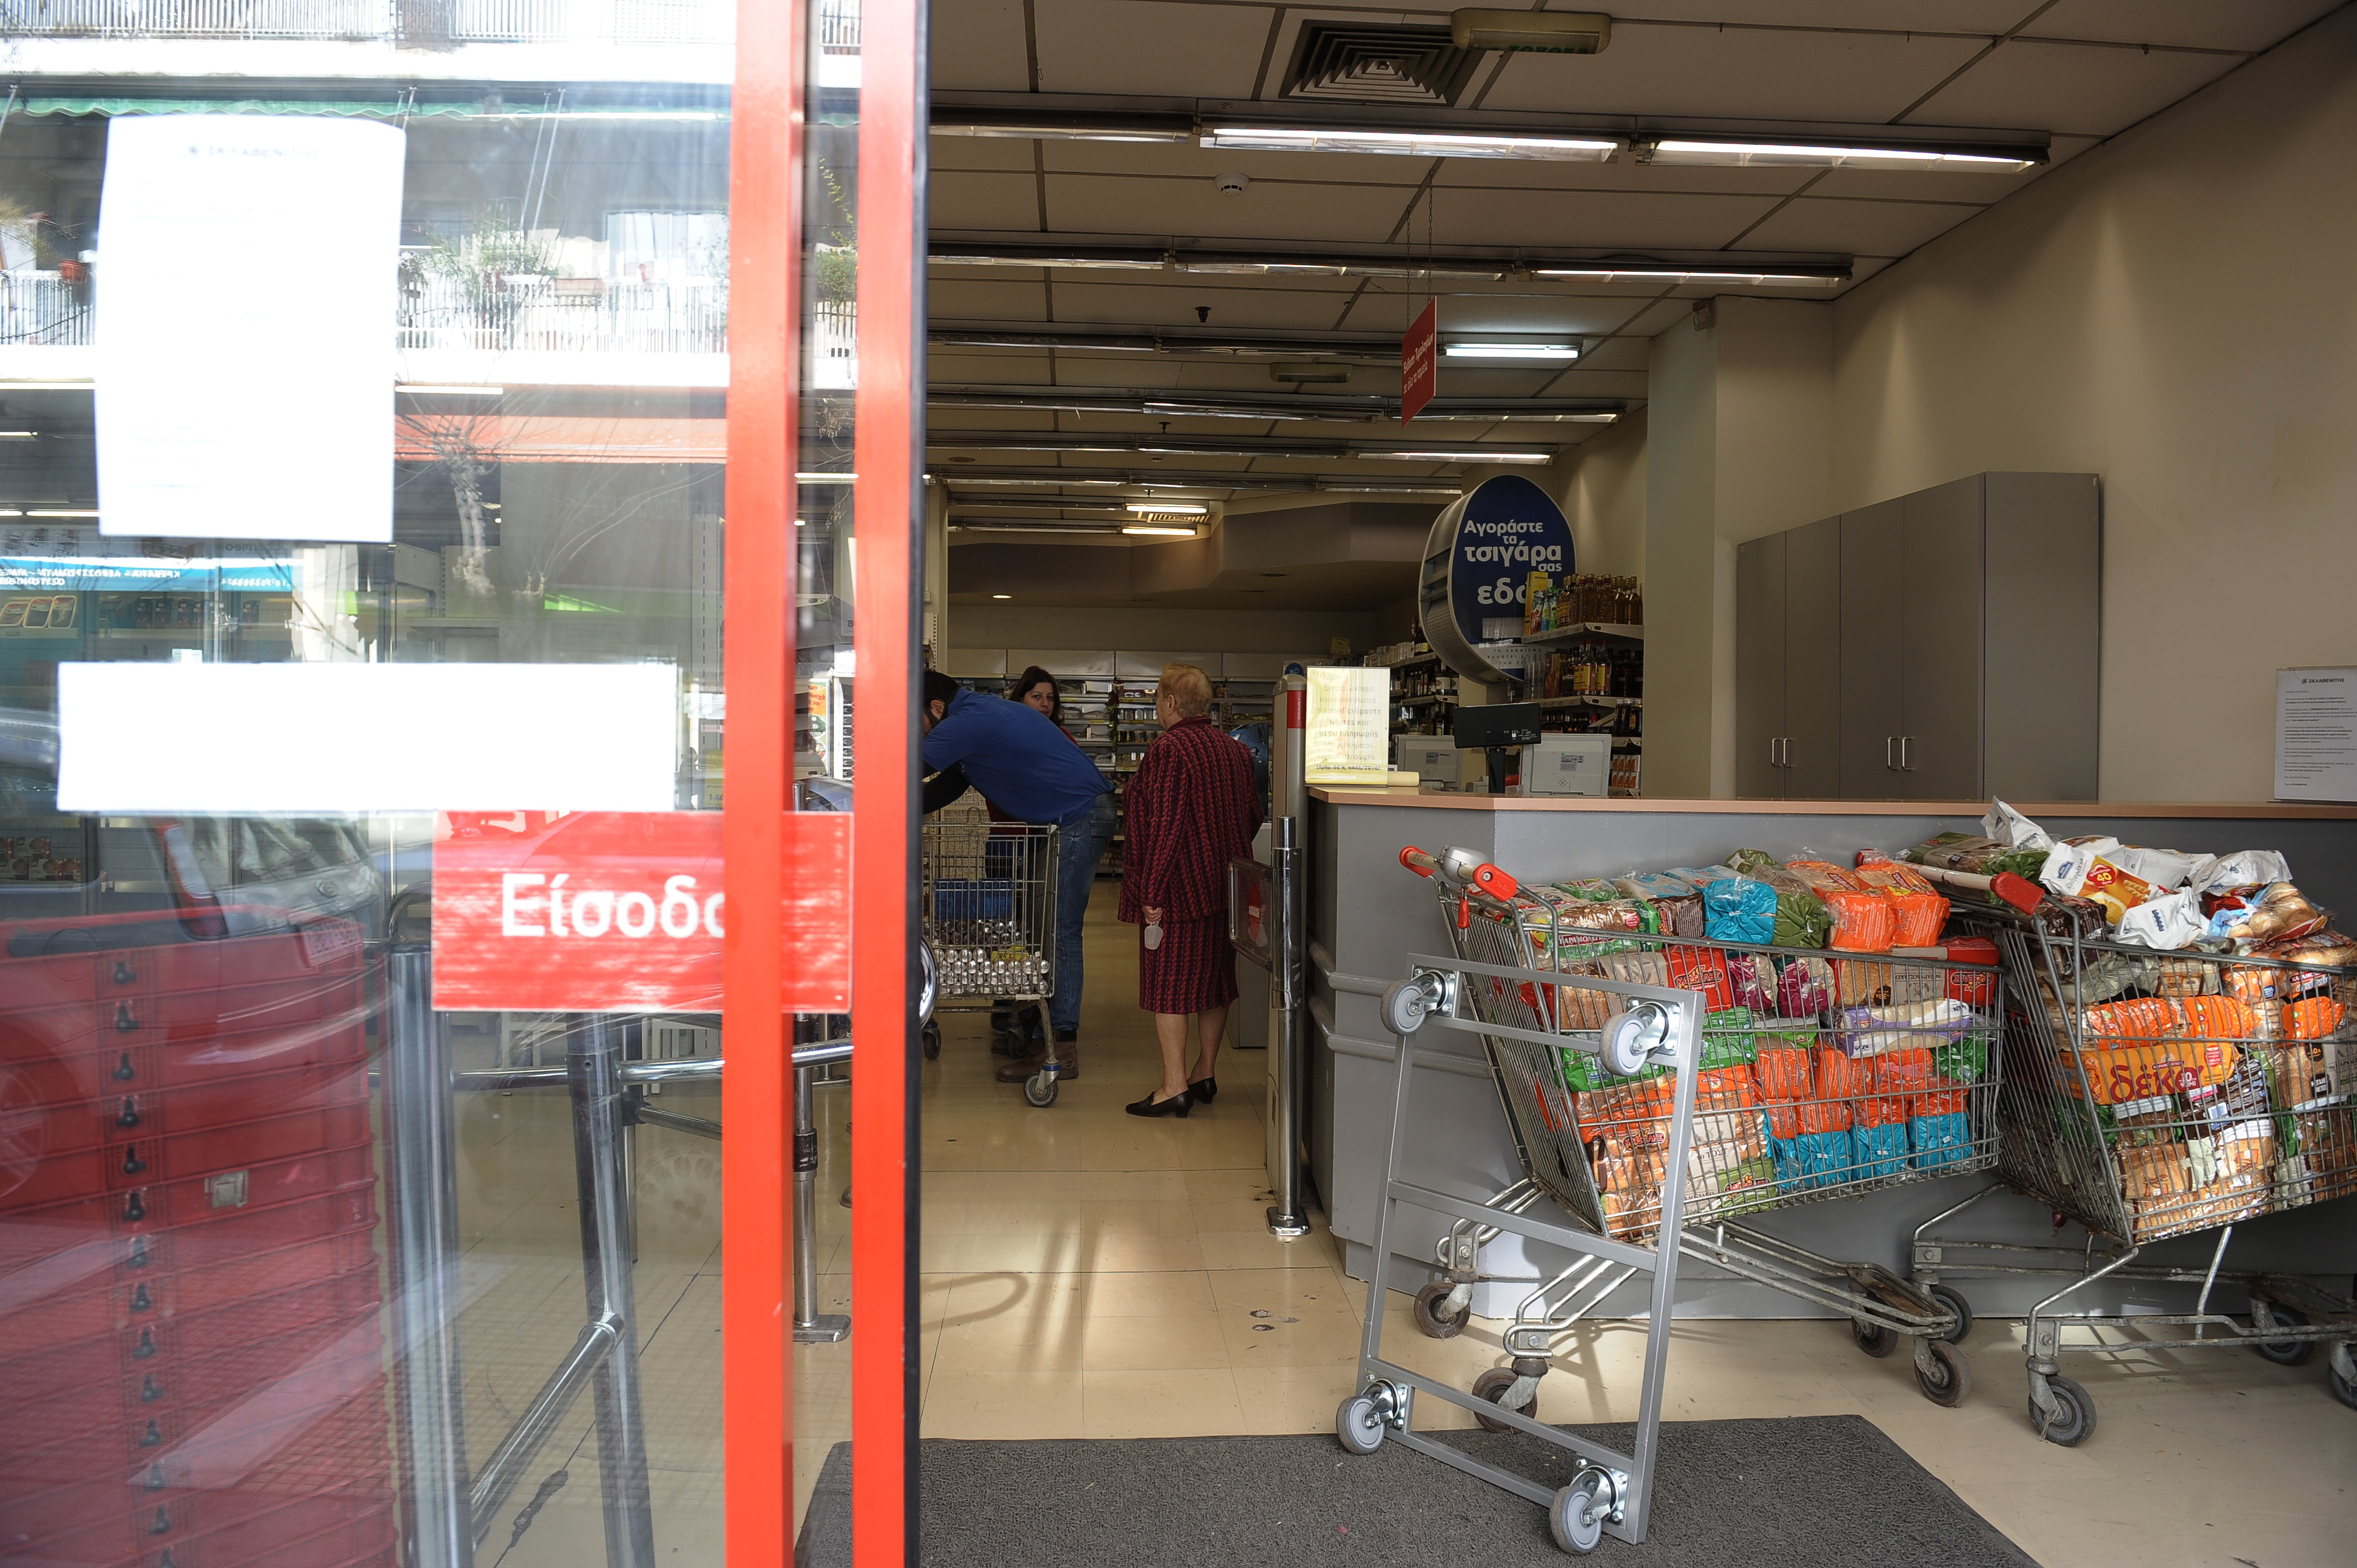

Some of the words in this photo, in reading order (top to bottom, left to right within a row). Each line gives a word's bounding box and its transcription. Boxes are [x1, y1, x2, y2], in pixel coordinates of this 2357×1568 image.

[1464, 519, 1543, 537] Αγοράστε
[1502, 535, 1517, 544] τα
[1464, 541, 1561, 567] τσιγάρα
[1538, 563, 1562, 571] σας
[2097, 873, 2112, 881] 40
[503, 873, 724, 938] Είσοδο
